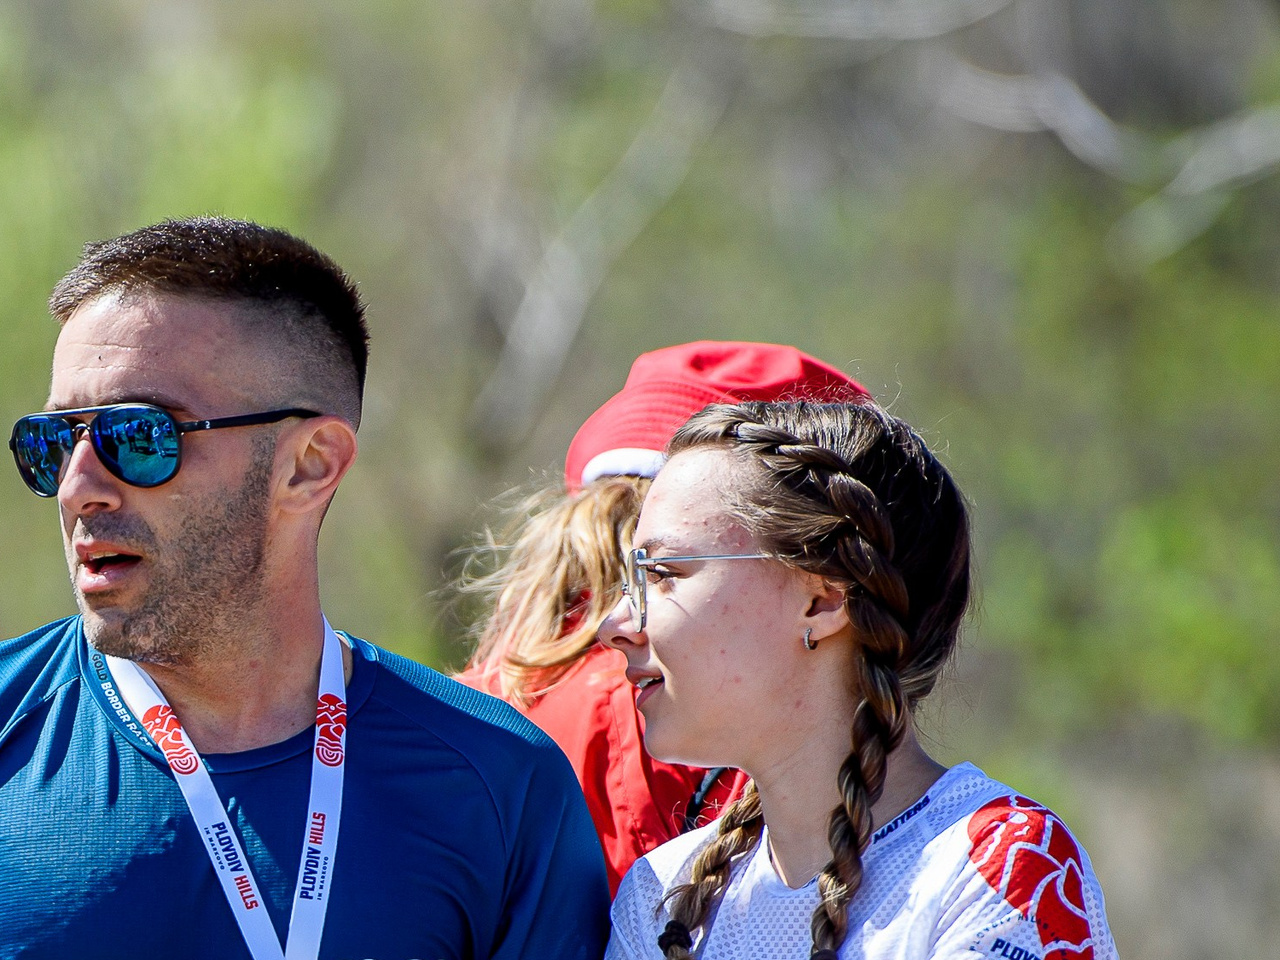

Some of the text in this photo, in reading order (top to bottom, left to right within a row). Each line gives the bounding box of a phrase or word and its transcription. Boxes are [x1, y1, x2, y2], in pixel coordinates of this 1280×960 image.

[92, 653, 108, 680] GOLD
[101, 682, 131, 722] BORDER
[873, 795, 930, 844] MATTERS
[208, 837, 225, 870] MARKOVO
[211, 821, 259, 910] PLOVDIV HILLS
[299, 812, 326, 900] PLOVDIV HILLS
[319, 856, 329, 889] MARKOVO
